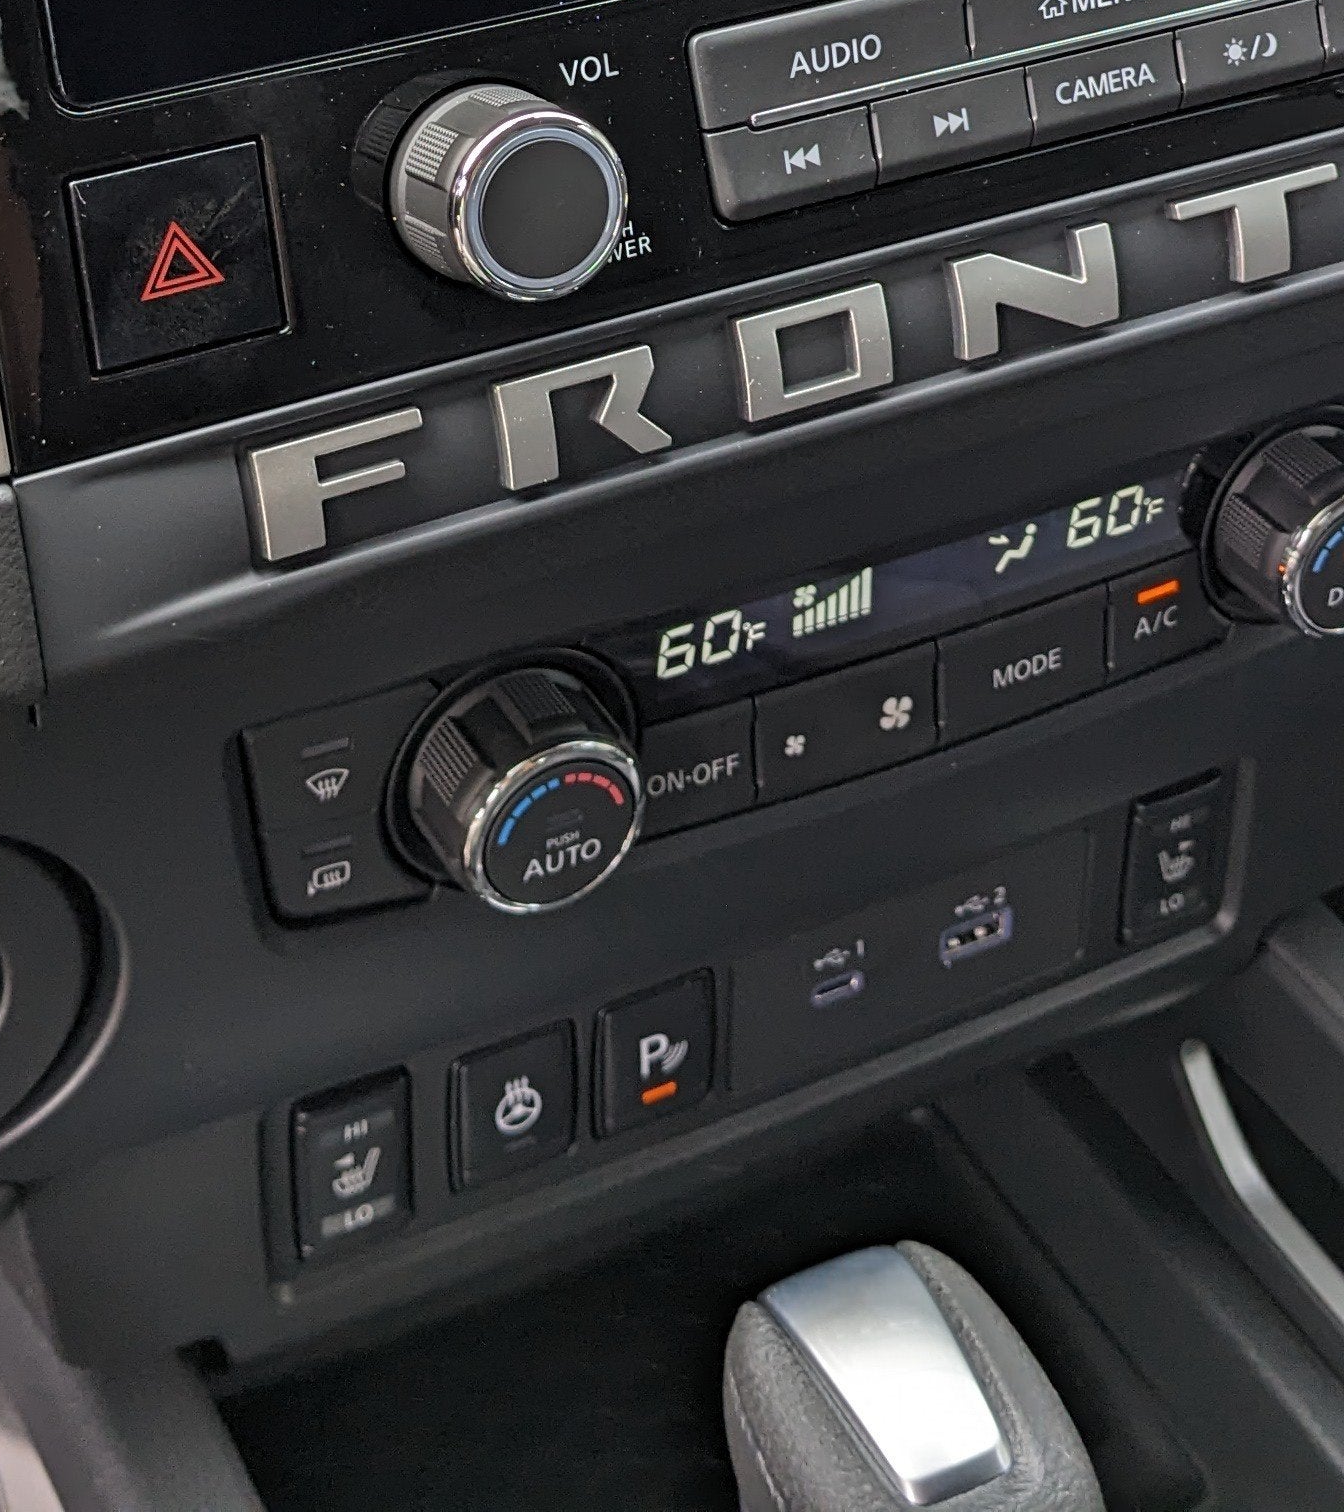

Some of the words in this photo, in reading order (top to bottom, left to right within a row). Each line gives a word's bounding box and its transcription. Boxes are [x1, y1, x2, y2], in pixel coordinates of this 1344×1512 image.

[560, 53, 620, 86] VOL
[789, 33, 882, 79] AUDIO
[1055, 62, 1155, 106] CAMERA
[1133, 604, 1179, 640] A/C
[993, 648, 1063, 689] MODE
[522, 838, 602, 883] AUTO
[344, 1202, 375, 1232] LO
